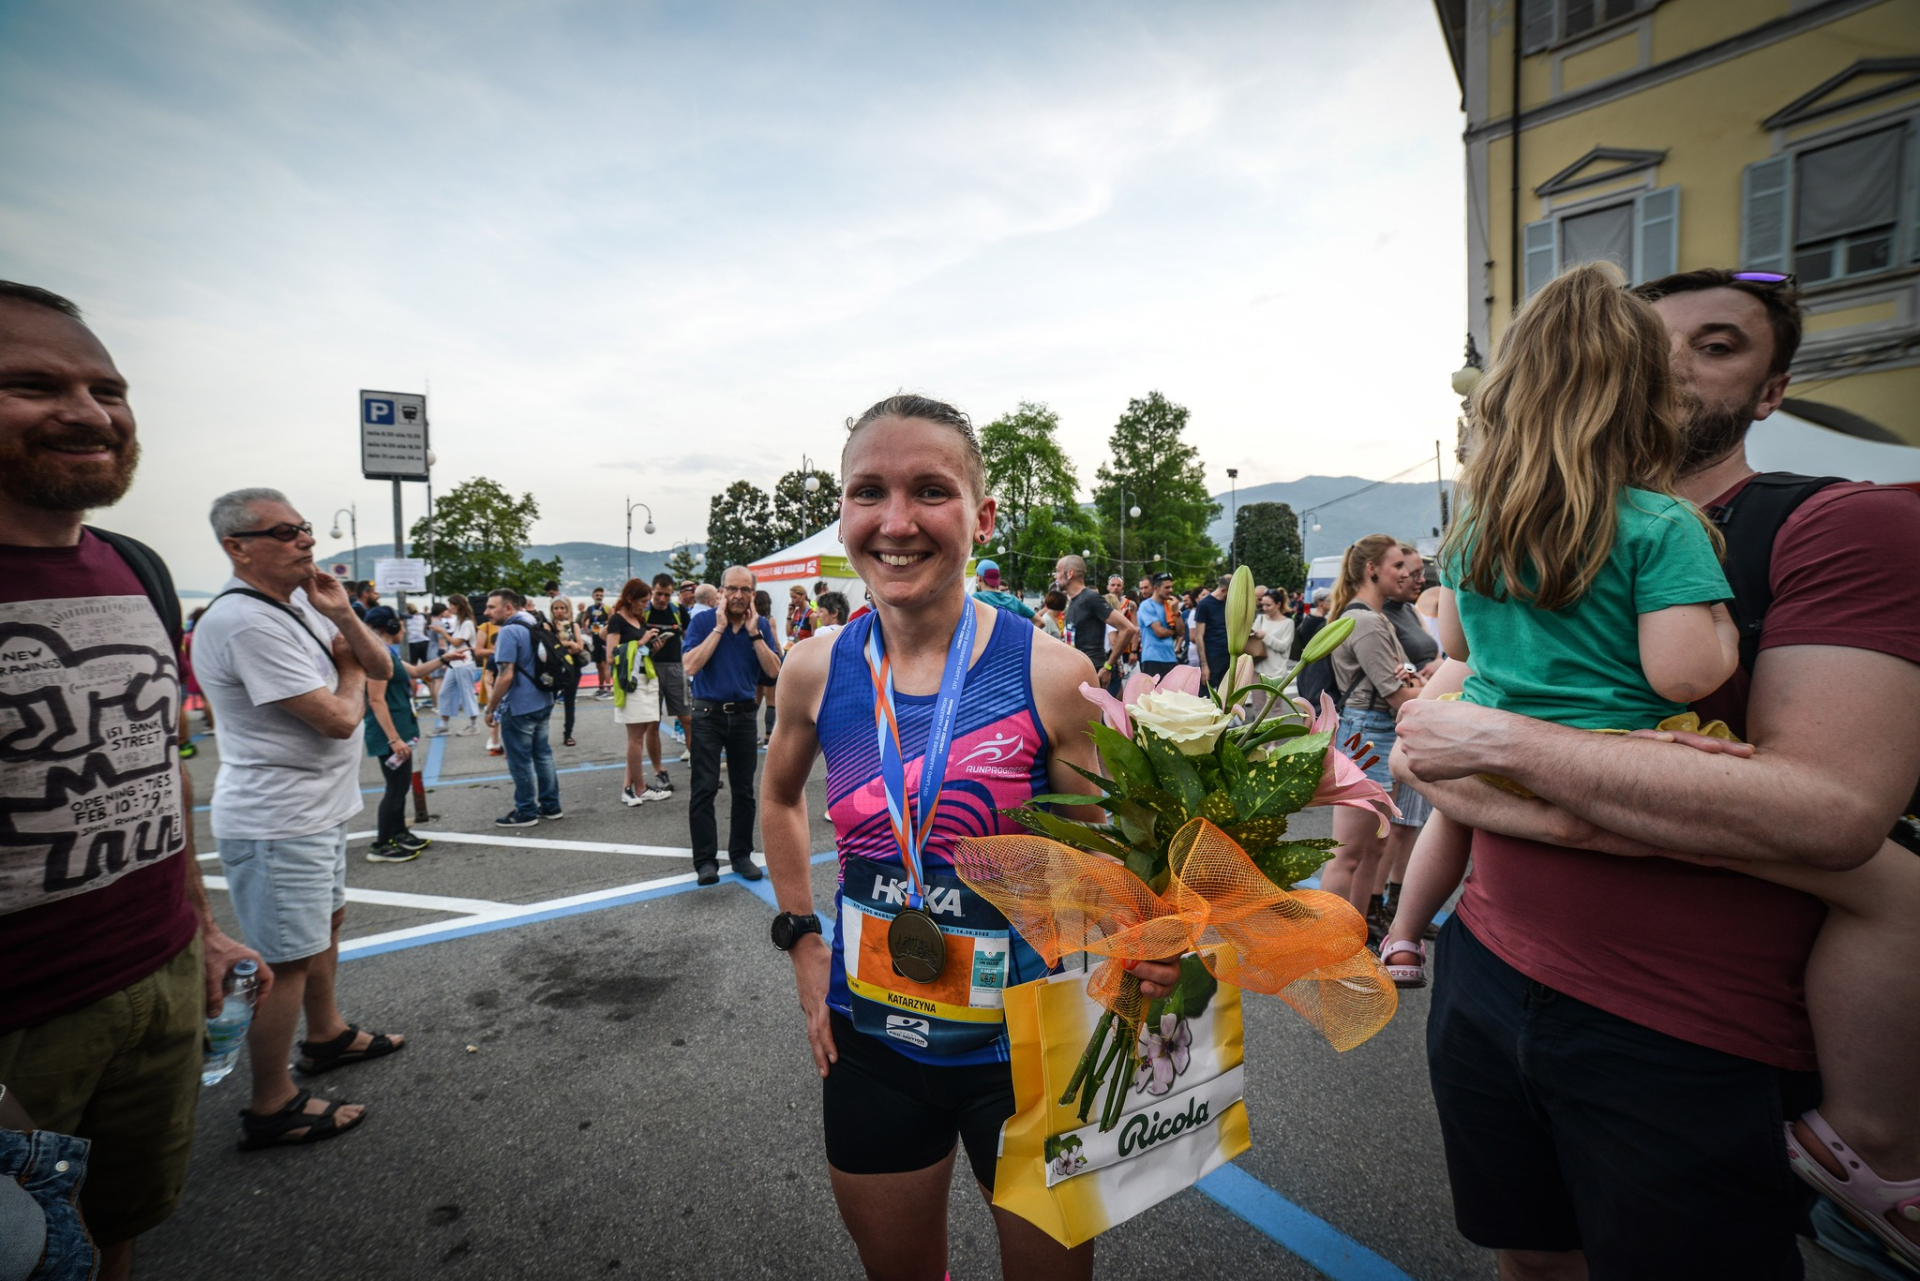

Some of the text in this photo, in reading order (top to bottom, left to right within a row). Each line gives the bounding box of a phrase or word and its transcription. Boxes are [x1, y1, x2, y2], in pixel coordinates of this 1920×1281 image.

[370, 402, 390, 421] P
[2, 647, 43, 661] NEW
[0, 658, 62, 677] RAWINGS
[106, 719, 161, 738] 151 BANK
[111, 731, 162, 751] STREET
[887, 992, 937, 1014] KATARZYNA
[1117, 1096, 1210, 1158] Ricola
